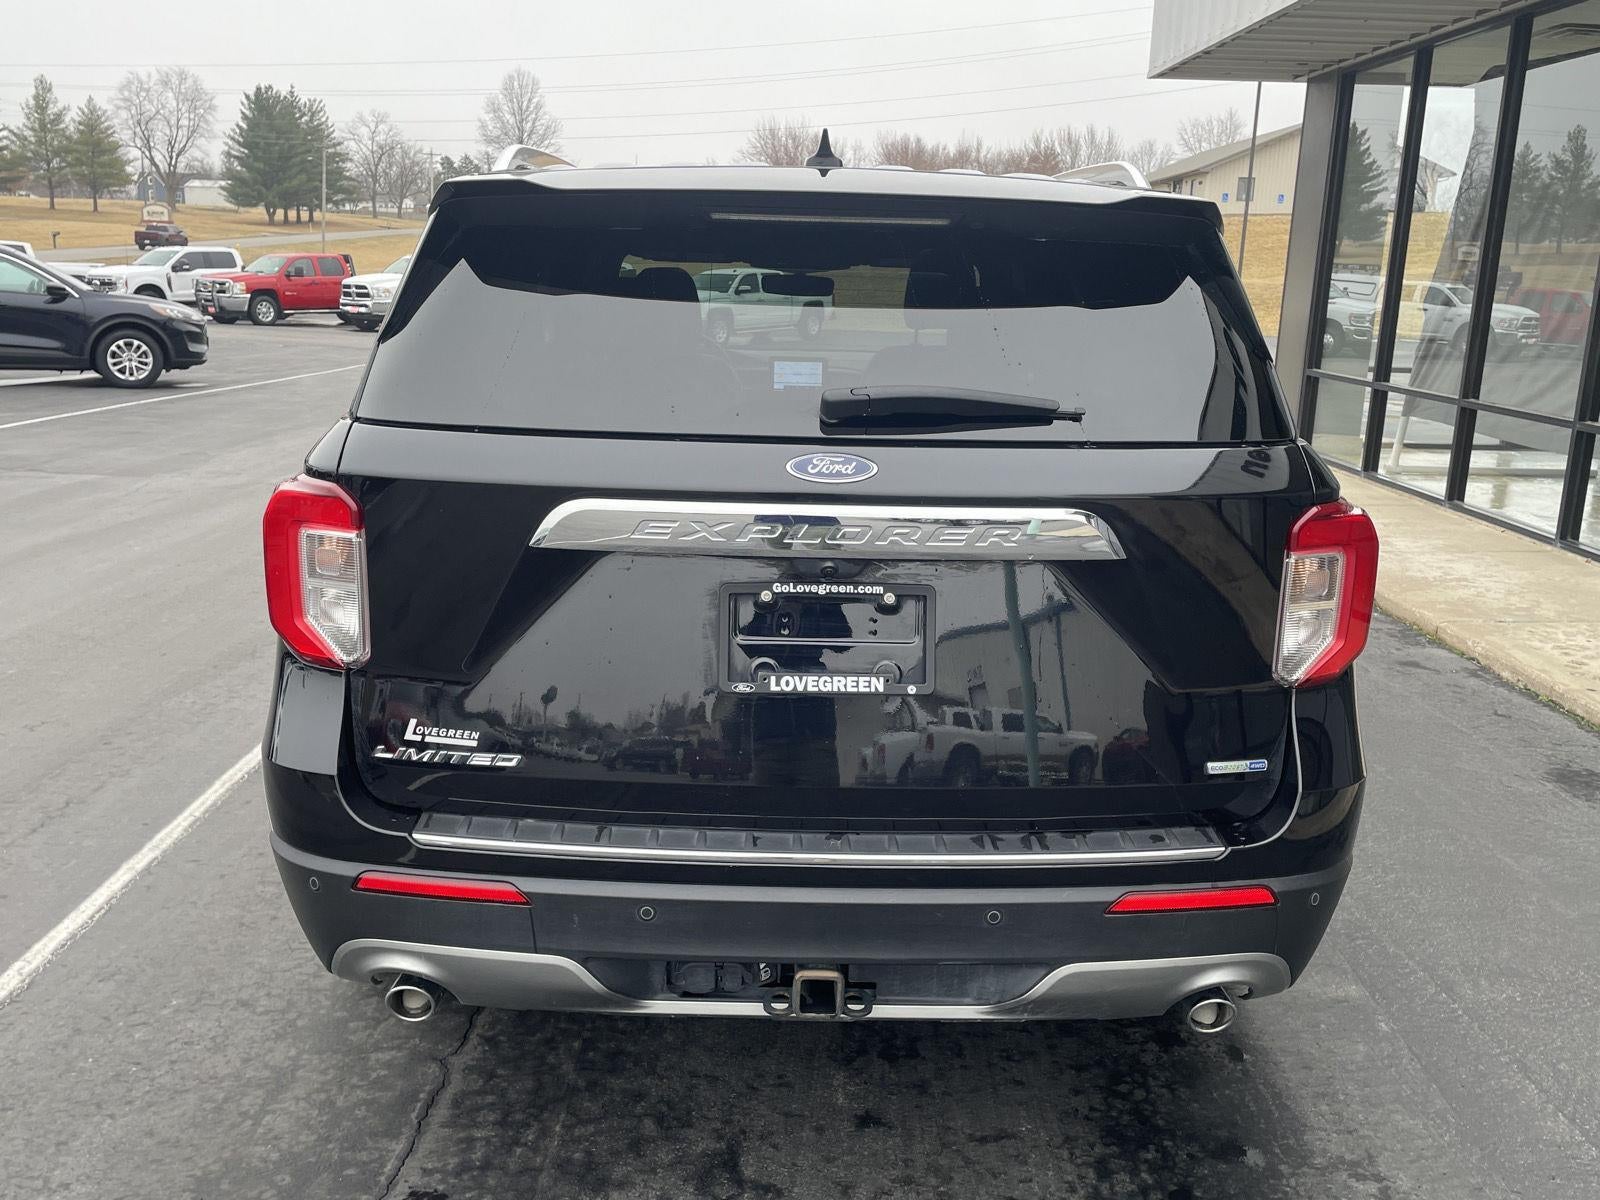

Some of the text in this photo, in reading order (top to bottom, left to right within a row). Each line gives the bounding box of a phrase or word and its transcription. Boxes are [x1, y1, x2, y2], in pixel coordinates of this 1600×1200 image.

[807, 456, 857, 475] Ford
[630, 518, 1023, 547] EXPLORER
[772, 582, 884, 595] GoLovegreen.com
[769, 675, 885, 692] LOVEGREEN
[373, 745, 522, 768] LIMITED
